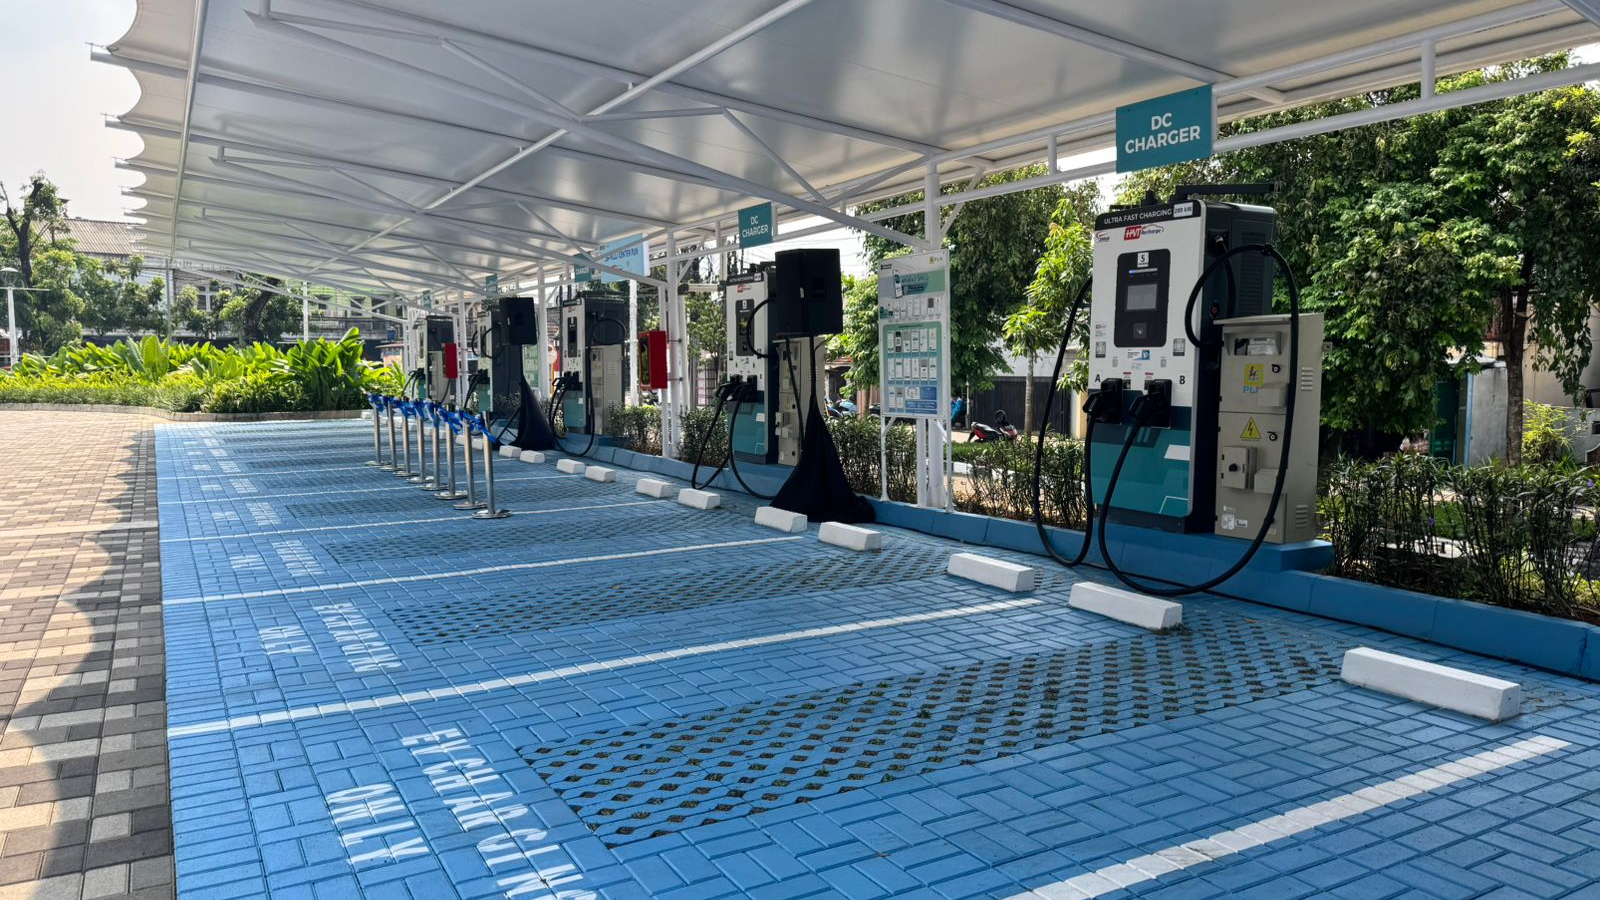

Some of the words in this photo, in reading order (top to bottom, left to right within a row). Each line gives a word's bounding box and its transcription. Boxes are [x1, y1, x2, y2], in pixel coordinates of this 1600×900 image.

[1151, 112, 1173, 131] DC
[1125, 125, 1200, 154] CHARGER
[750, 215, 759, 225] DC
[1103, 216, 1123, 225] ULTRA
[1123, 213, 1139, 222] FAST
[1139, 208, 1172, 220] CHARGING
[741, 224, 769, 238] CHARGER
[1140, 254, 1146, 262] 5
[1094, 373, 1101, 383] A
[1179, 375, 1186, 385] B
[401, 727, 473, 756] EV
[325, 783, 431, 865] ONLY
